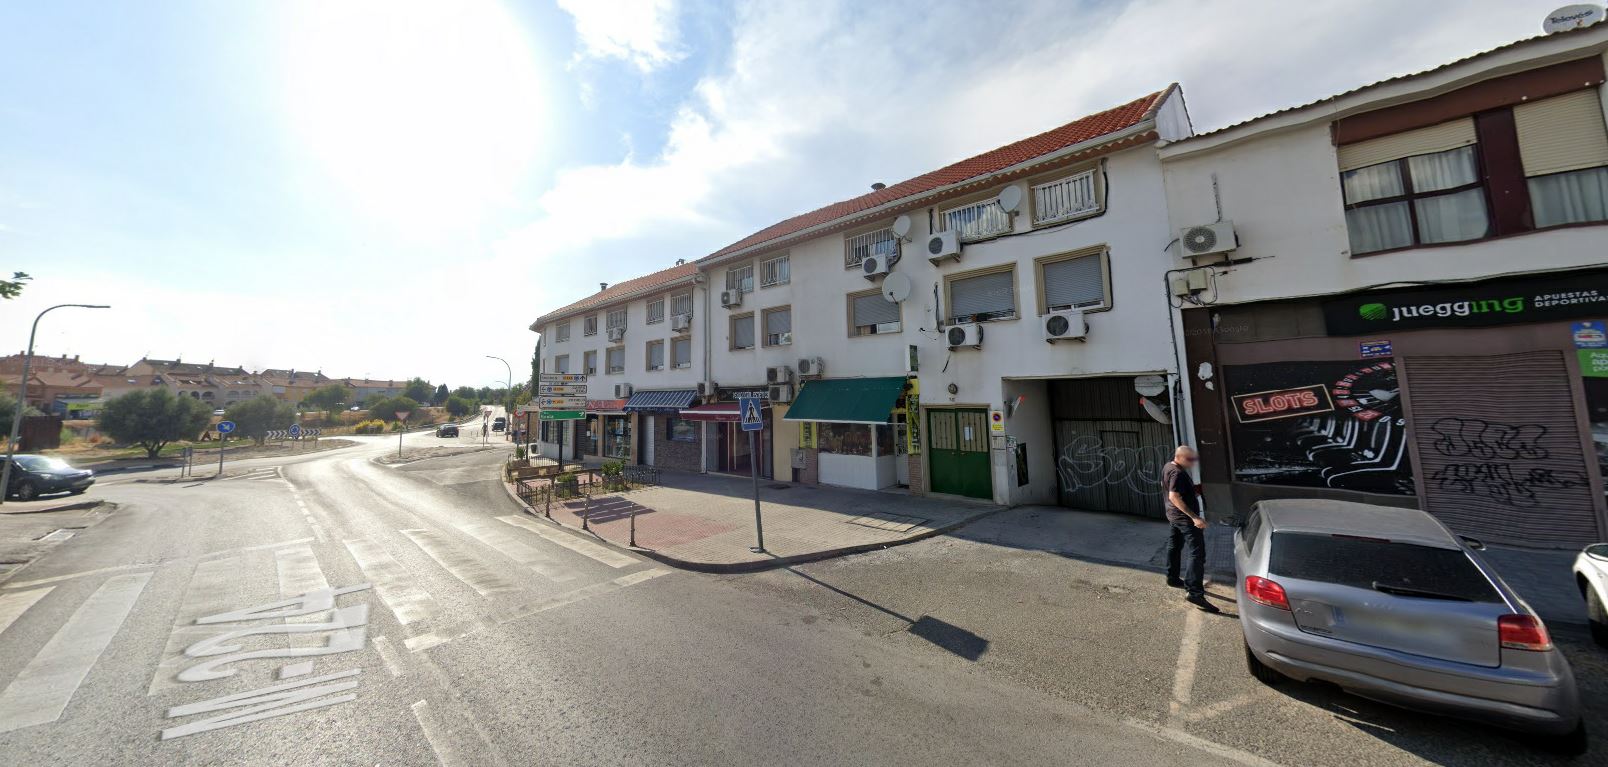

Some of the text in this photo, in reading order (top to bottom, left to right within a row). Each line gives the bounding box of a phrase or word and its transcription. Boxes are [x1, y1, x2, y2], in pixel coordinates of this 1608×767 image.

[1534, 290, 1598, 302] APUESTAS
[1393, 297, 1524, 321] juegging
[1242, 391, 1319, 415] SLOTS
[161, 583, 372, 740] M-224
